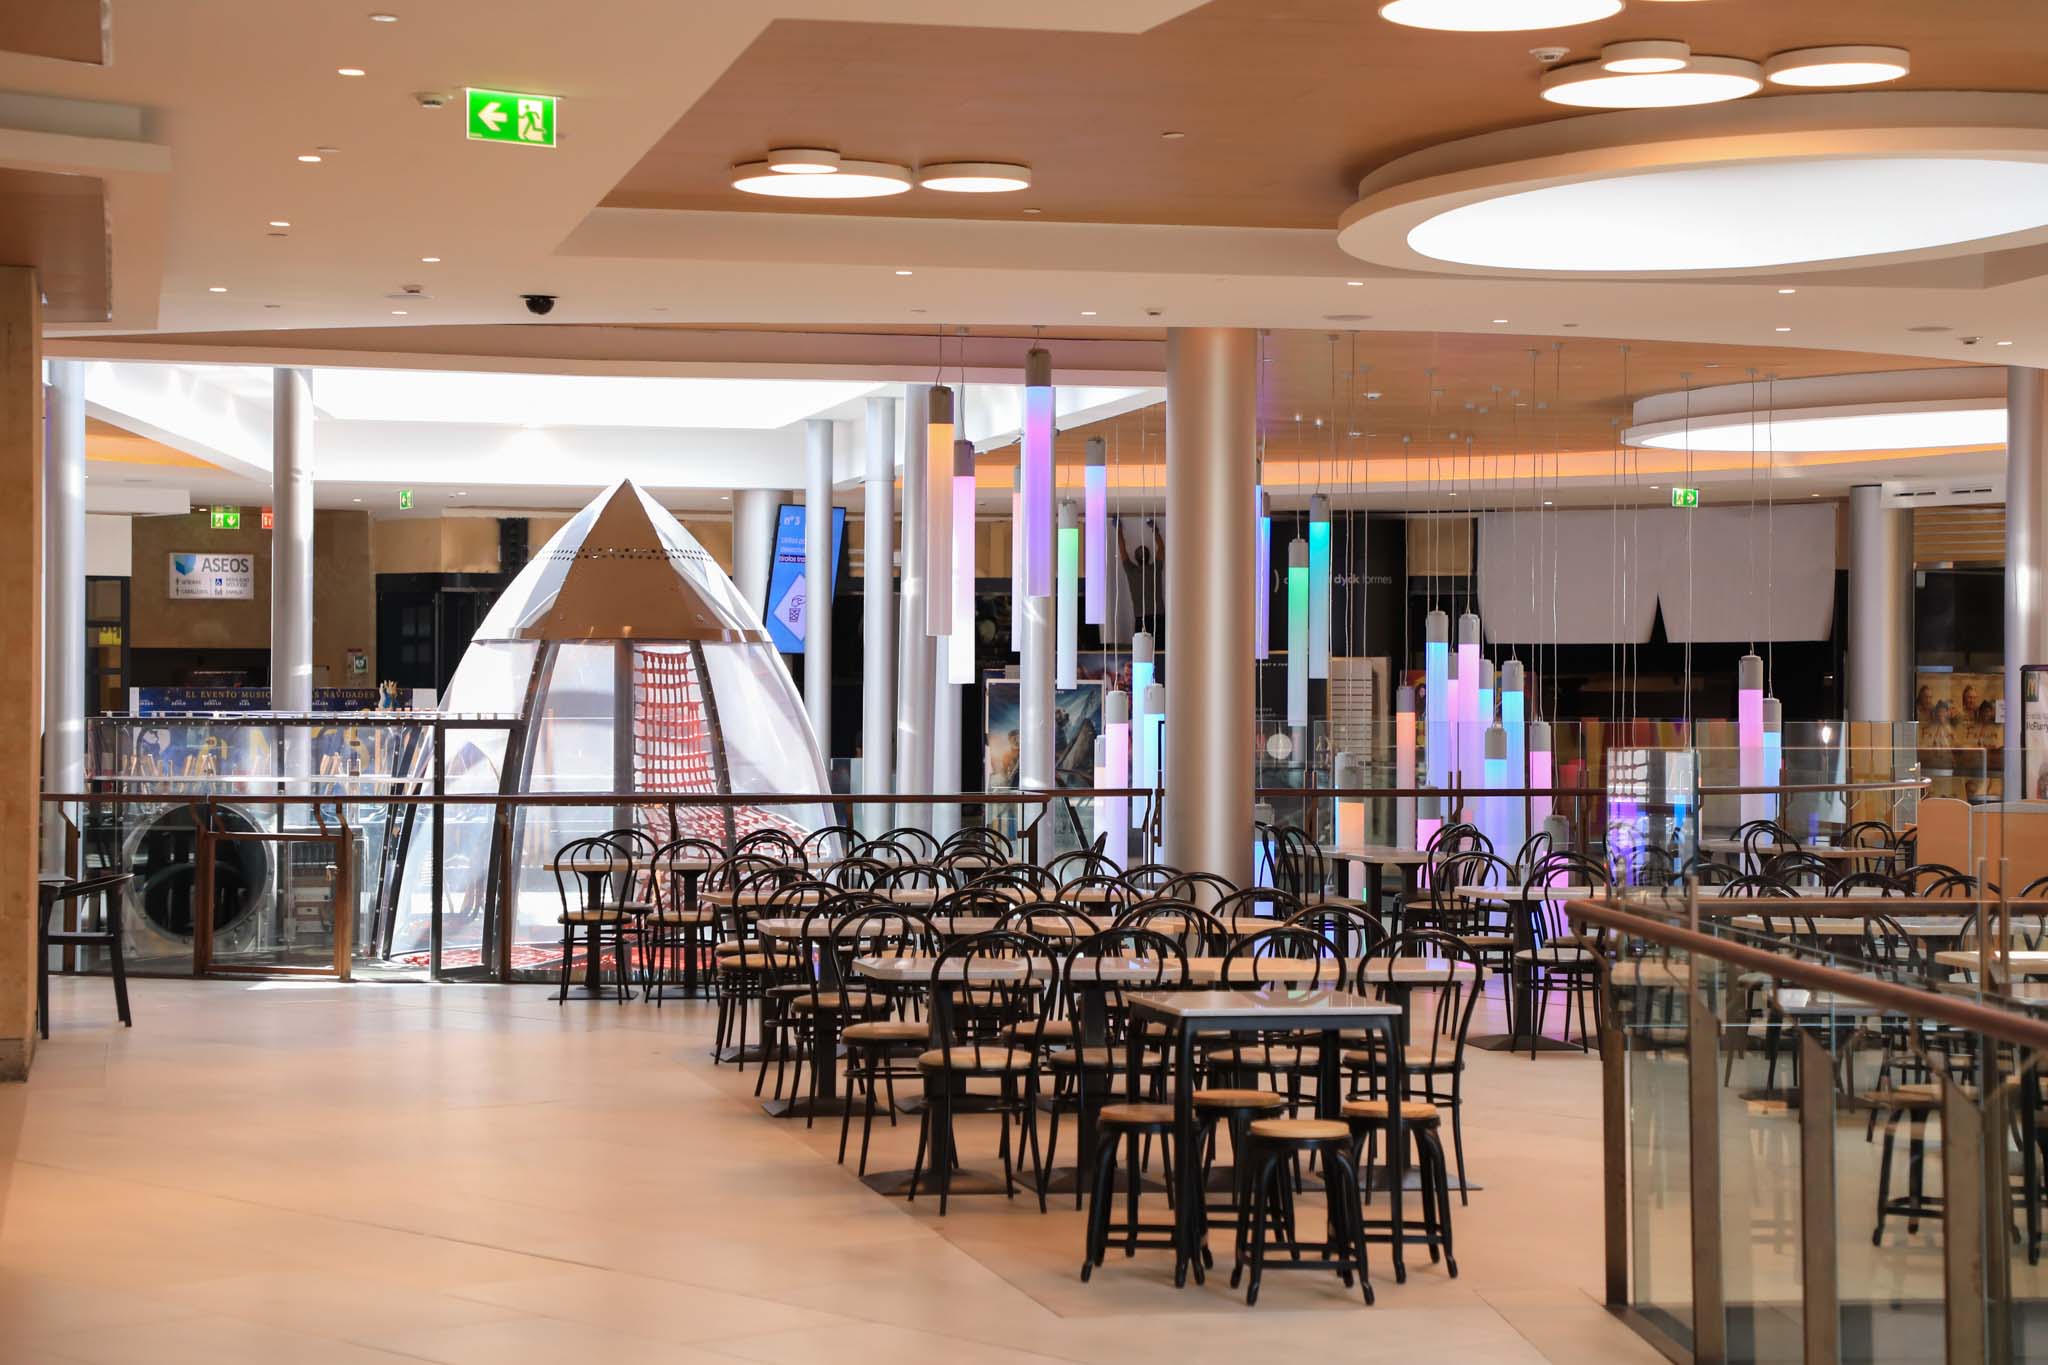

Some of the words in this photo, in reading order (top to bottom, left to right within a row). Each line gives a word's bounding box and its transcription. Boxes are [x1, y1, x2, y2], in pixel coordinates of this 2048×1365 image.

[201, 557, 249, 573] ASEOS
[185, 690, 196, 698] EL
[200, 690, 237, 698] EVENTO
[241, 690, 271, 698] MUSIC
[323, 690, 376, 699] NAVIDADES
